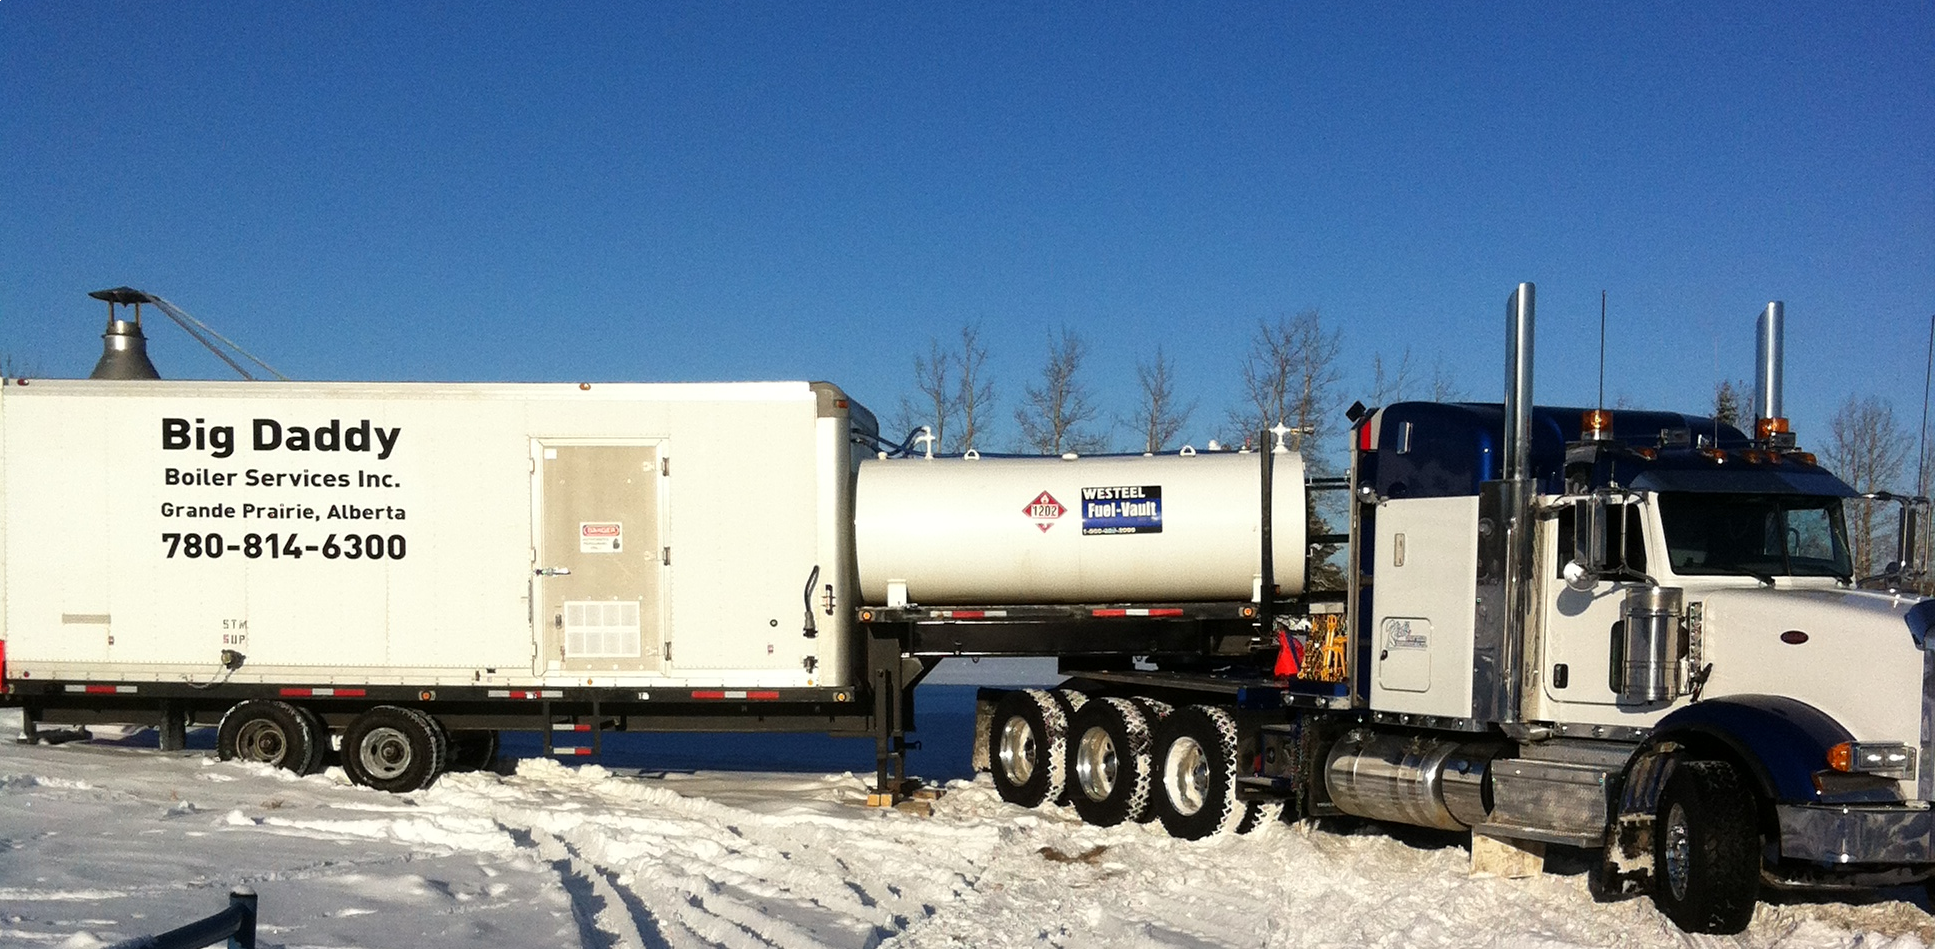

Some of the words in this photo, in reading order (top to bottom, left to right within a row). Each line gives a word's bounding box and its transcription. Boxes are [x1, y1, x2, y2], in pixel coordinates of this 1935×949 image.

[162, 418, 234, 458] Big
[253, 418, 402, 460] Daddy
[165, 468, 238, 486] Boiler
[245, 469, 350, 488] Services
[358, 470, 400, 488] Inc.
[1083, 487, 1146, 500] WESTEEL
[161, 502, 236, 518] Grande
[243, 503, 320, 522] Prairie,
[327, 504, 406, 520] Alberta
[1032, 505, 1057, 517] 1202
[1088, 501, 1157, 518] Fuel-Vault
[162, 533, 406, 560] 780-814-6300
[222, 619, 248, 630] STM
[223, 633, 246, 645] SUP
